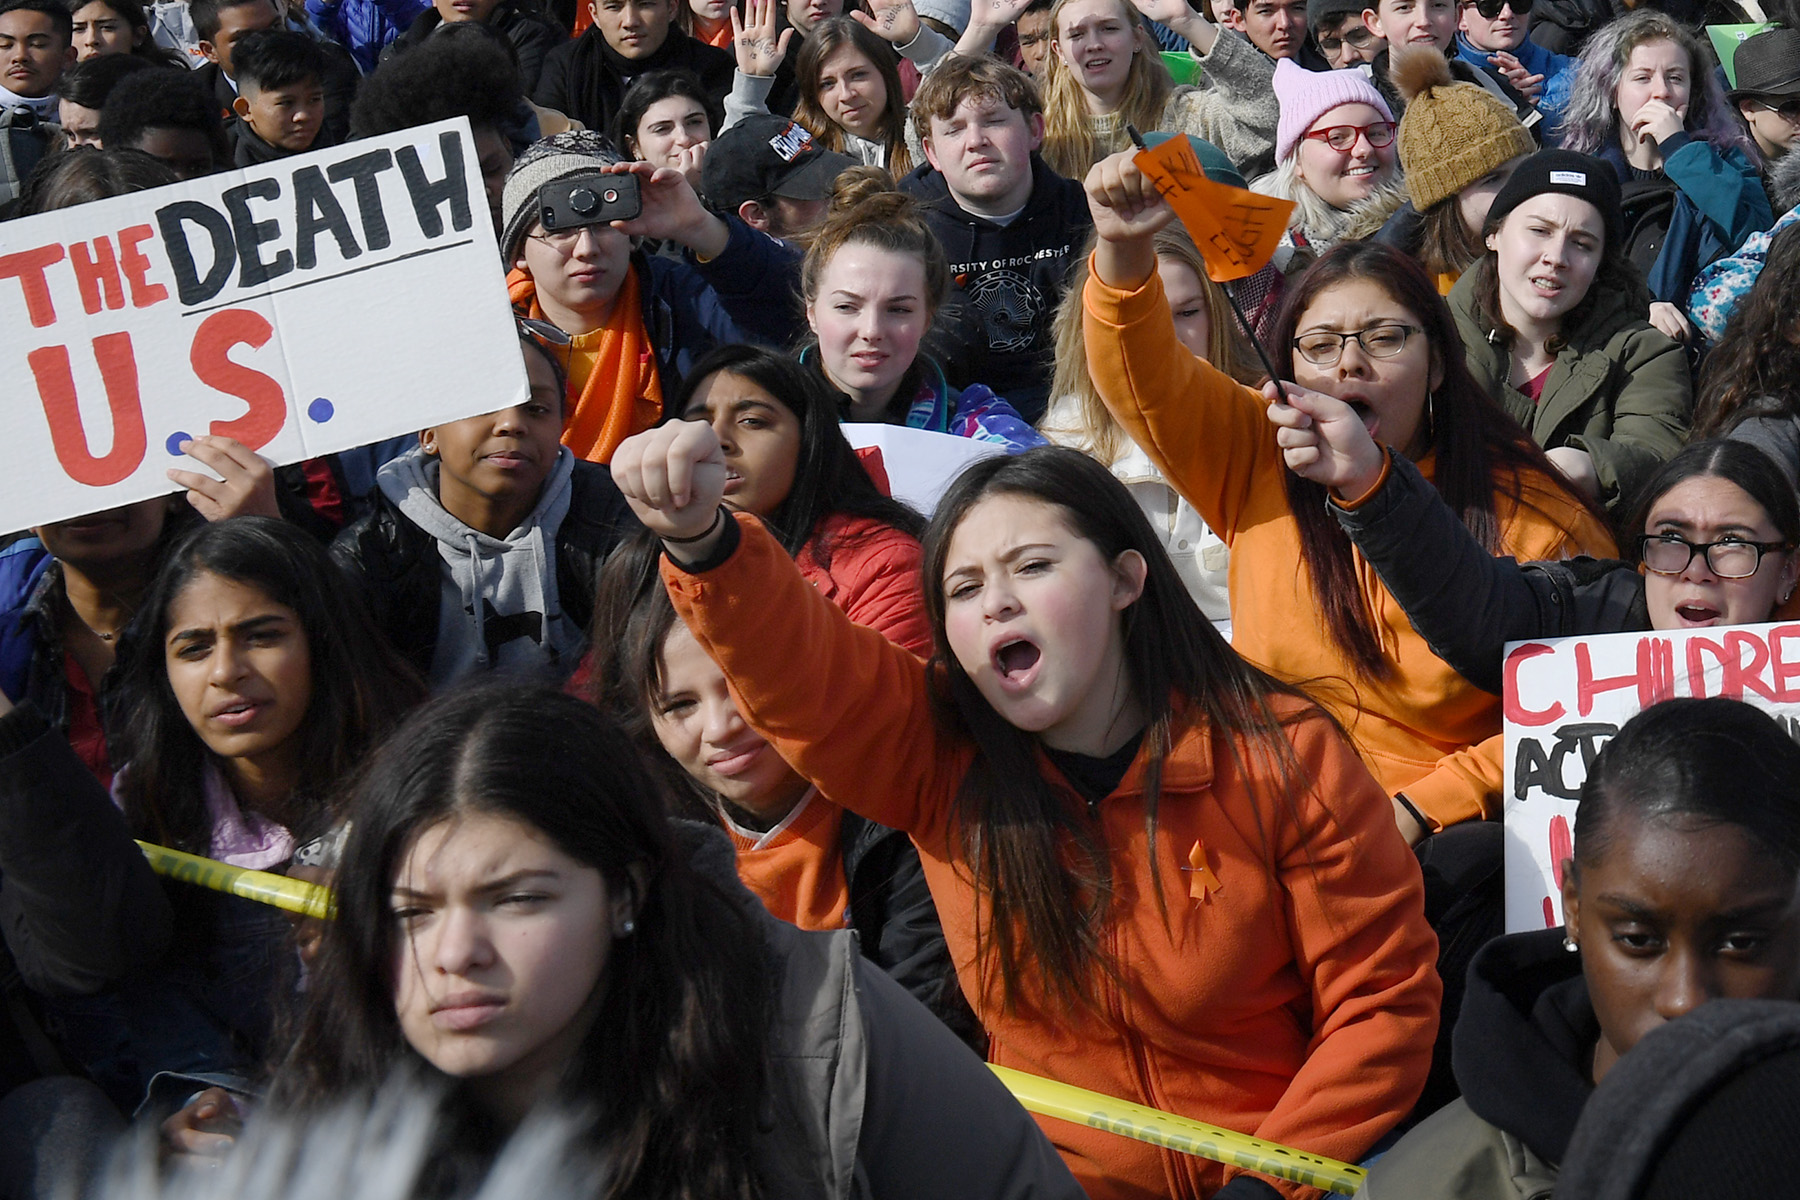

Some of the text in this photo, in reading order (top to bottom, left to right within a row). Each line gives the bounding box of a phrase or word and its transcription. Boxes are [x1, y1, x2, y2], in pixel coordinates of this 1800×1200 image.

[882, 3, 910, 31] ENOUGH
[741, 38, 775, 59] ENOUGH
[0, 130, 473, 328] THE DEATH
[992, 259, 1007, 269] OF
[27, 308, 334, 487] U.S.
